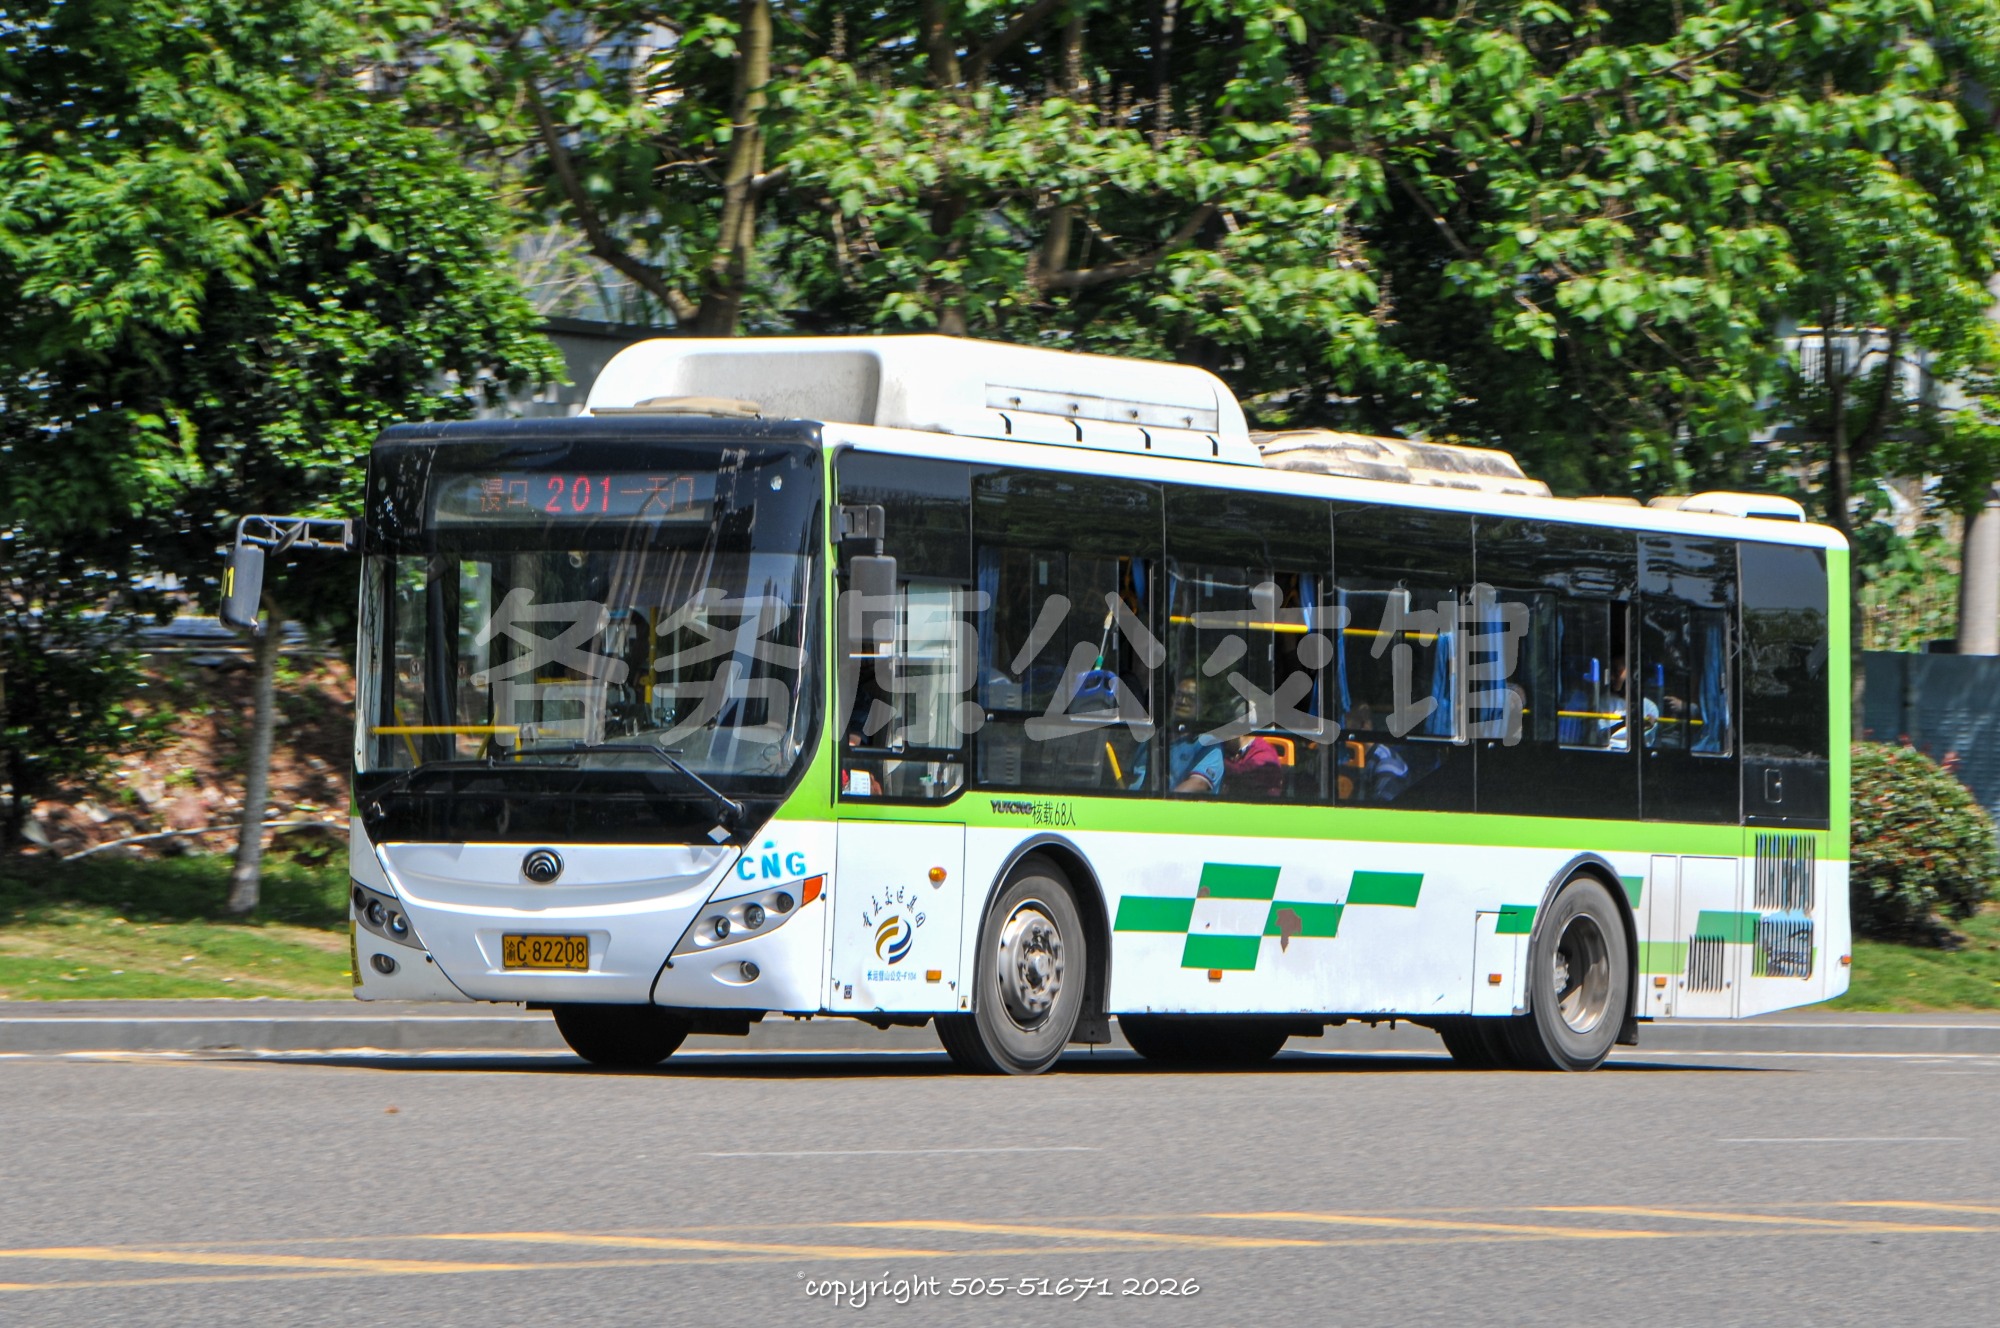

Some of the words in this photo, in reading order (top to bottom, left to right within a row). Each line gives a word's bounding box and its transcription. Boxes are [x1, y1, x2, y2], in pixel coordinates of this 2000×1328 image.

[546, 476, 610, 512] 201
[1032, 800, 1076, 826] 核载68人
[736, 852, 807, 880] CNG
